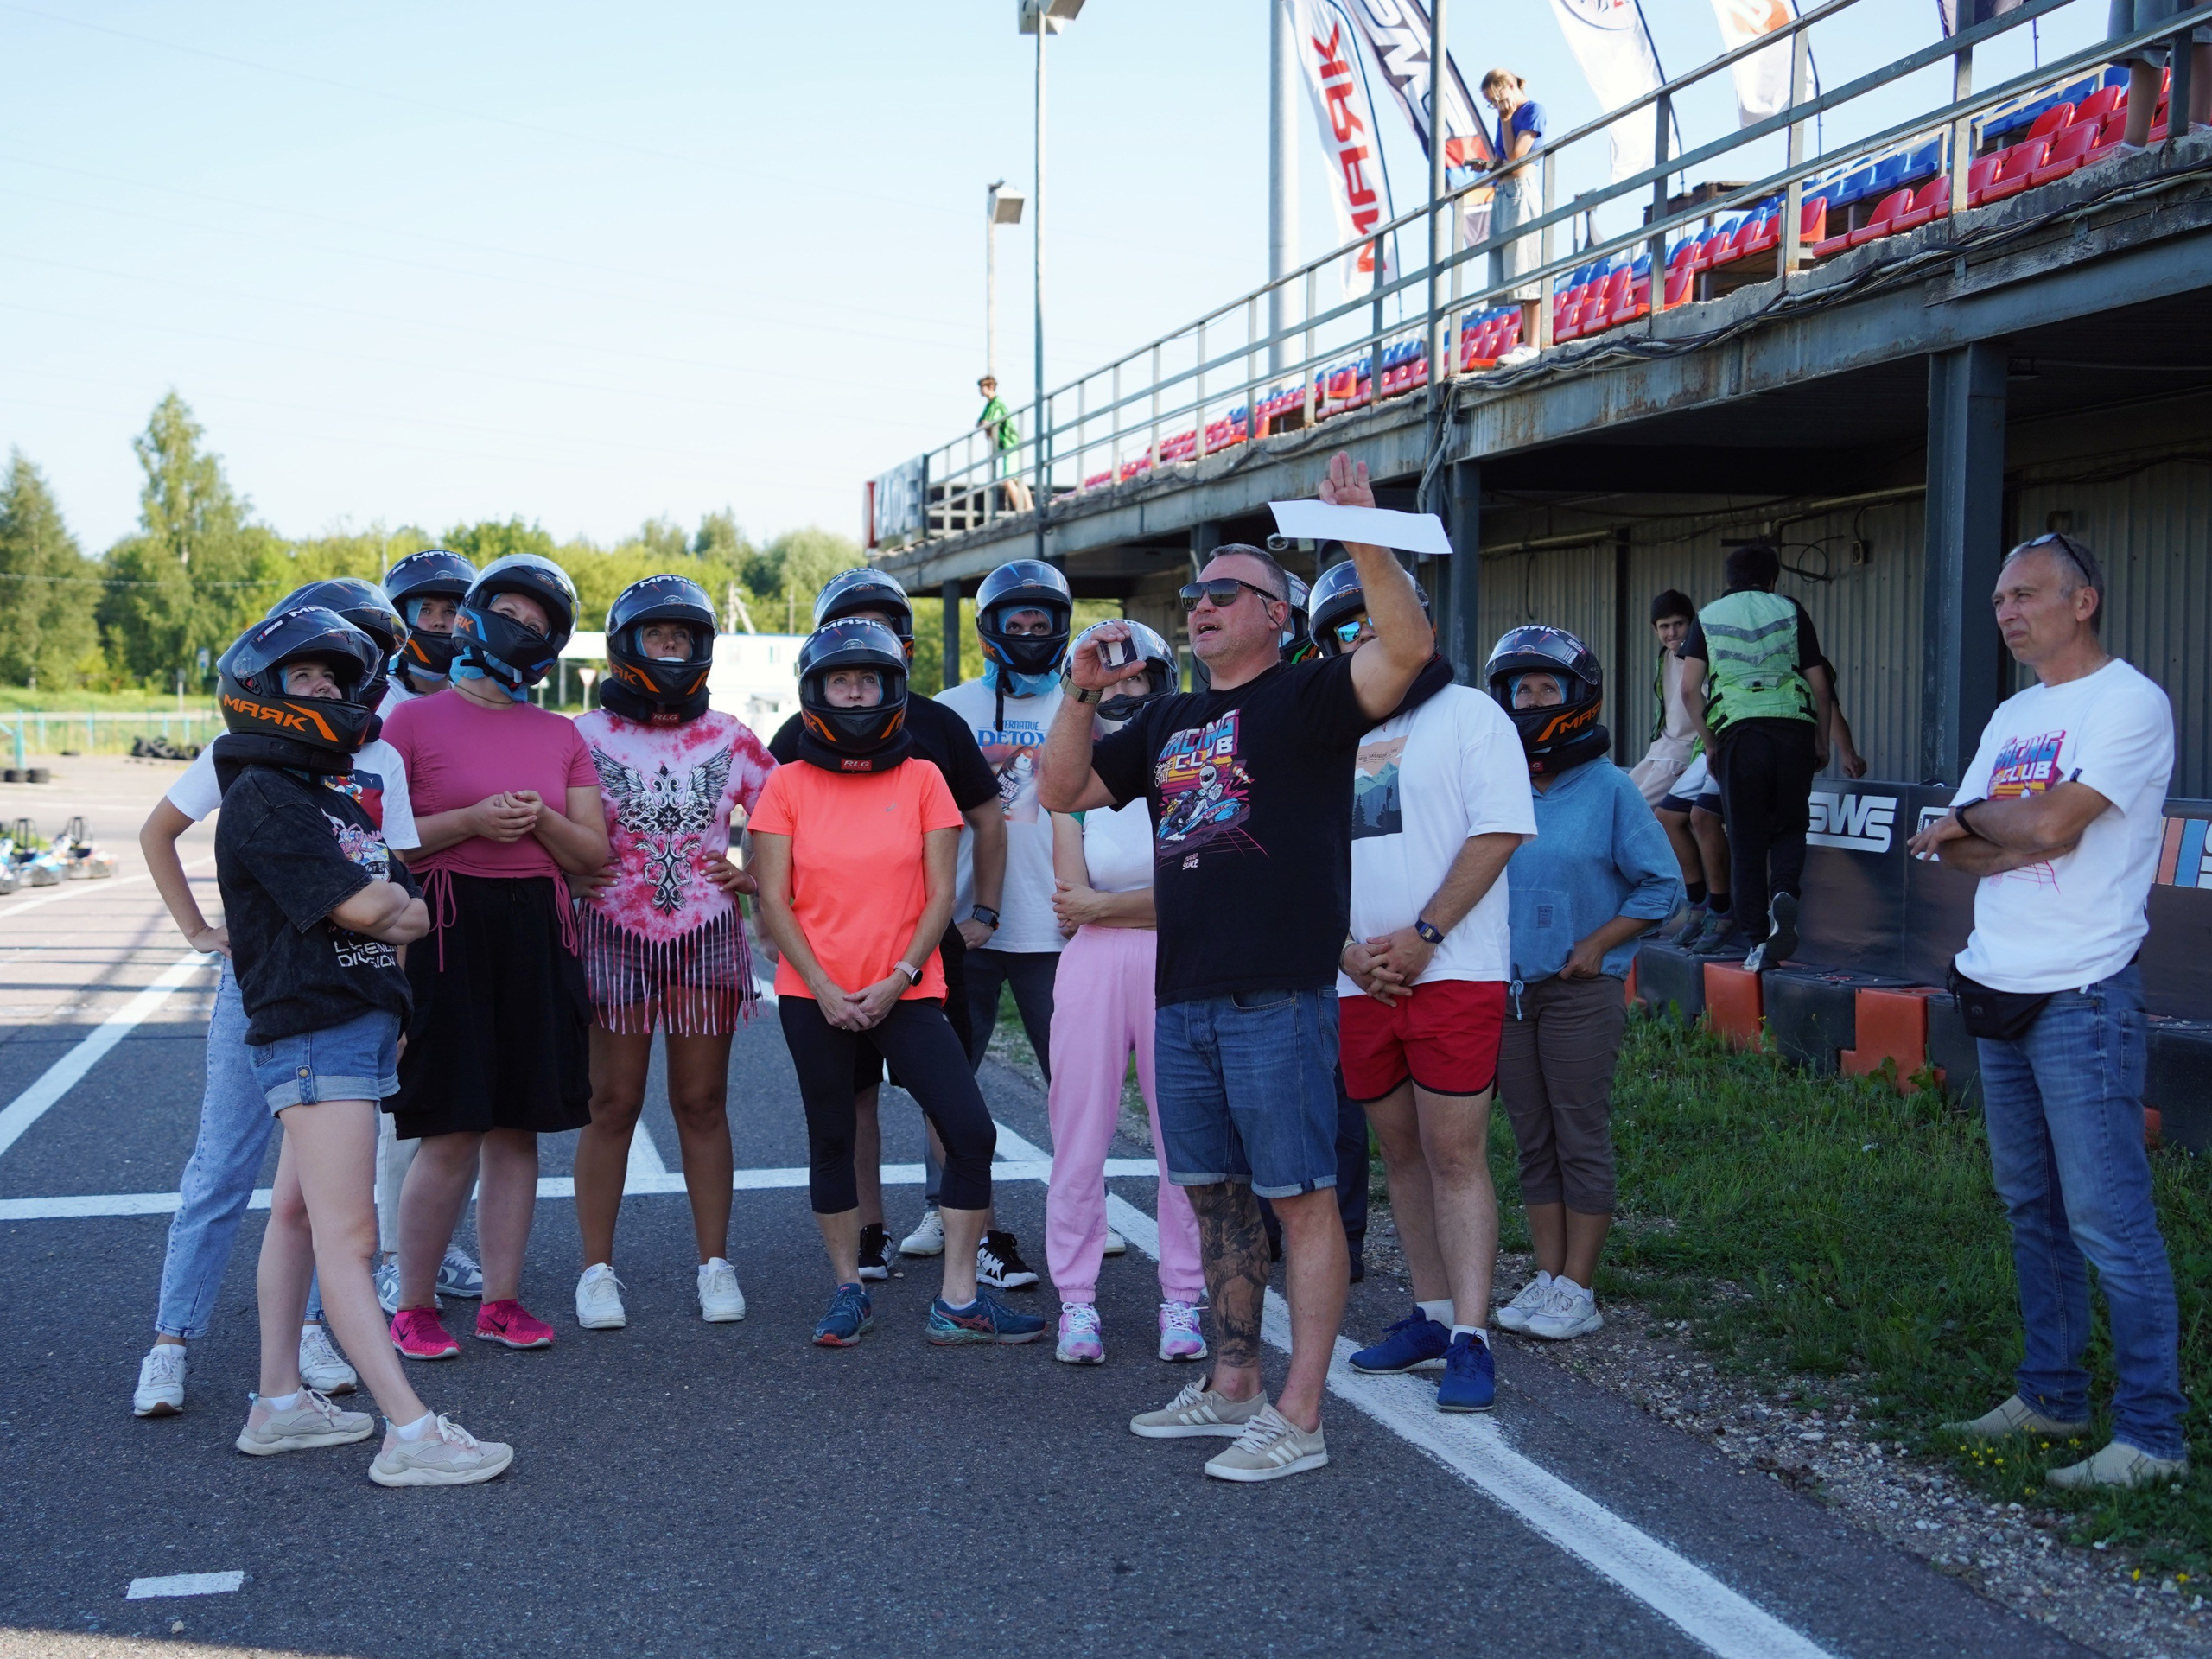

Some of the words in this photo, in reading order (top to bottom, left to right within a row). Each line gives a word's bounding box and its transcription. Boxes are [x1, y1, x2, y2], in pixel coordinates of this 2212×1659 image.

[821, 619, 885, 633] МАЯК
[223, 693, 308, 732] МАЯК
[1158, 709, 1239, 761] RACING
[1174, 735, 1234, 771] CLUB
[1993, 730, 2066, 770] RACING
[997, 772, 1020, 793] DIESEL
